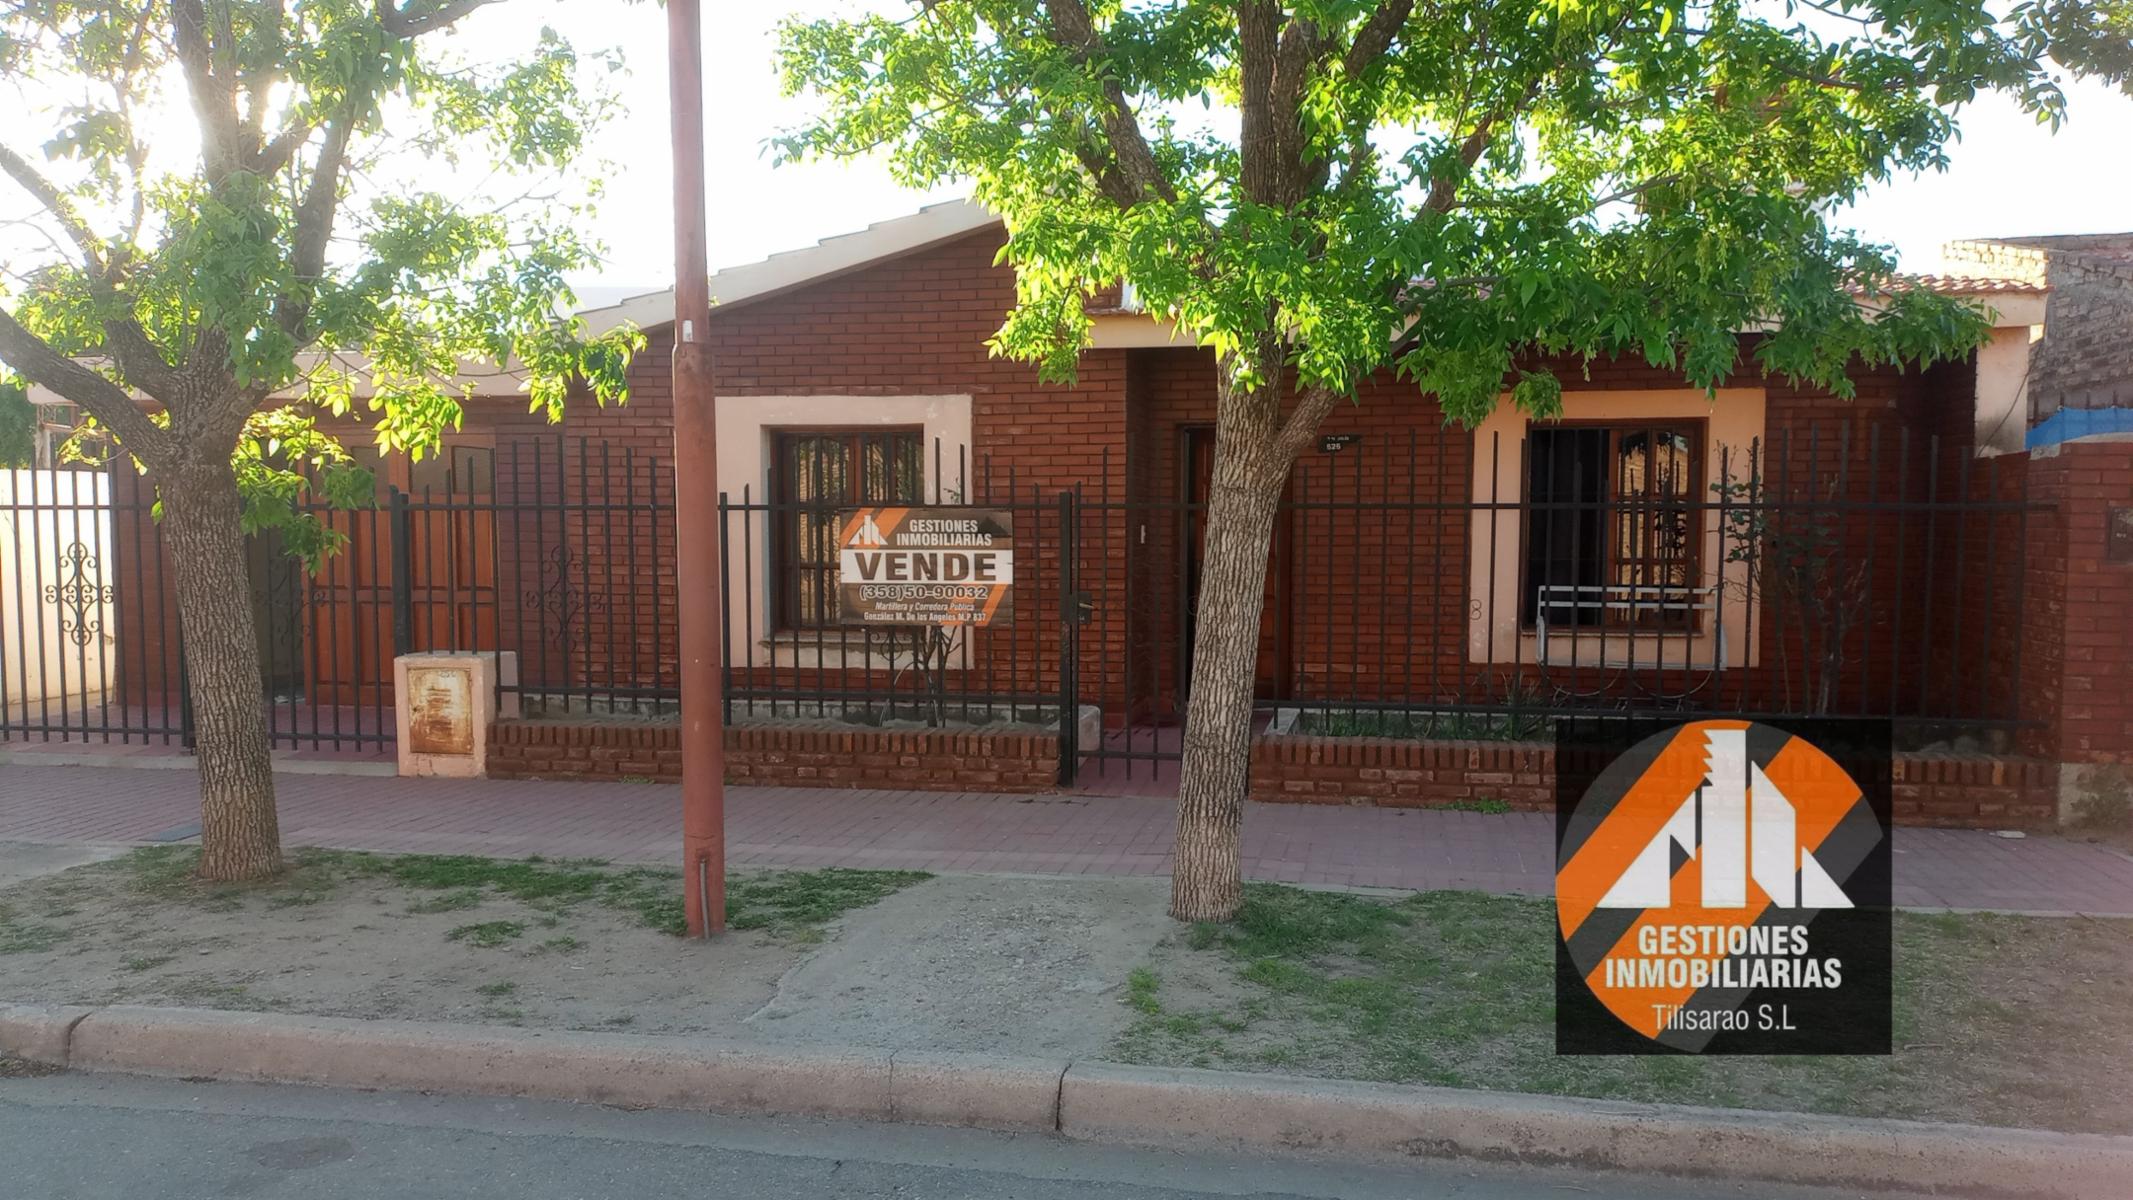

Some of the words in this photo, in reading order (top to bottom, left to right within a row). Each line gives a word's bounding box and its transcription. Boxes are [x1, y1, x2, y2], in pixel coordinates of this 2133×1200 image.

[909, 519, 978, 533] GESTIONES
[896, 533, 992, 546] INMOBILIARIAS
[854, 552, 996, 581] VENDE
[859, 585, 988, 601] (358)50-90032
[875, 602, 908, 610] Martillera
[909, 604, 914, 612] y
[915, 602, 948, 611] Corredora
[917, 612, 927, 621] los
